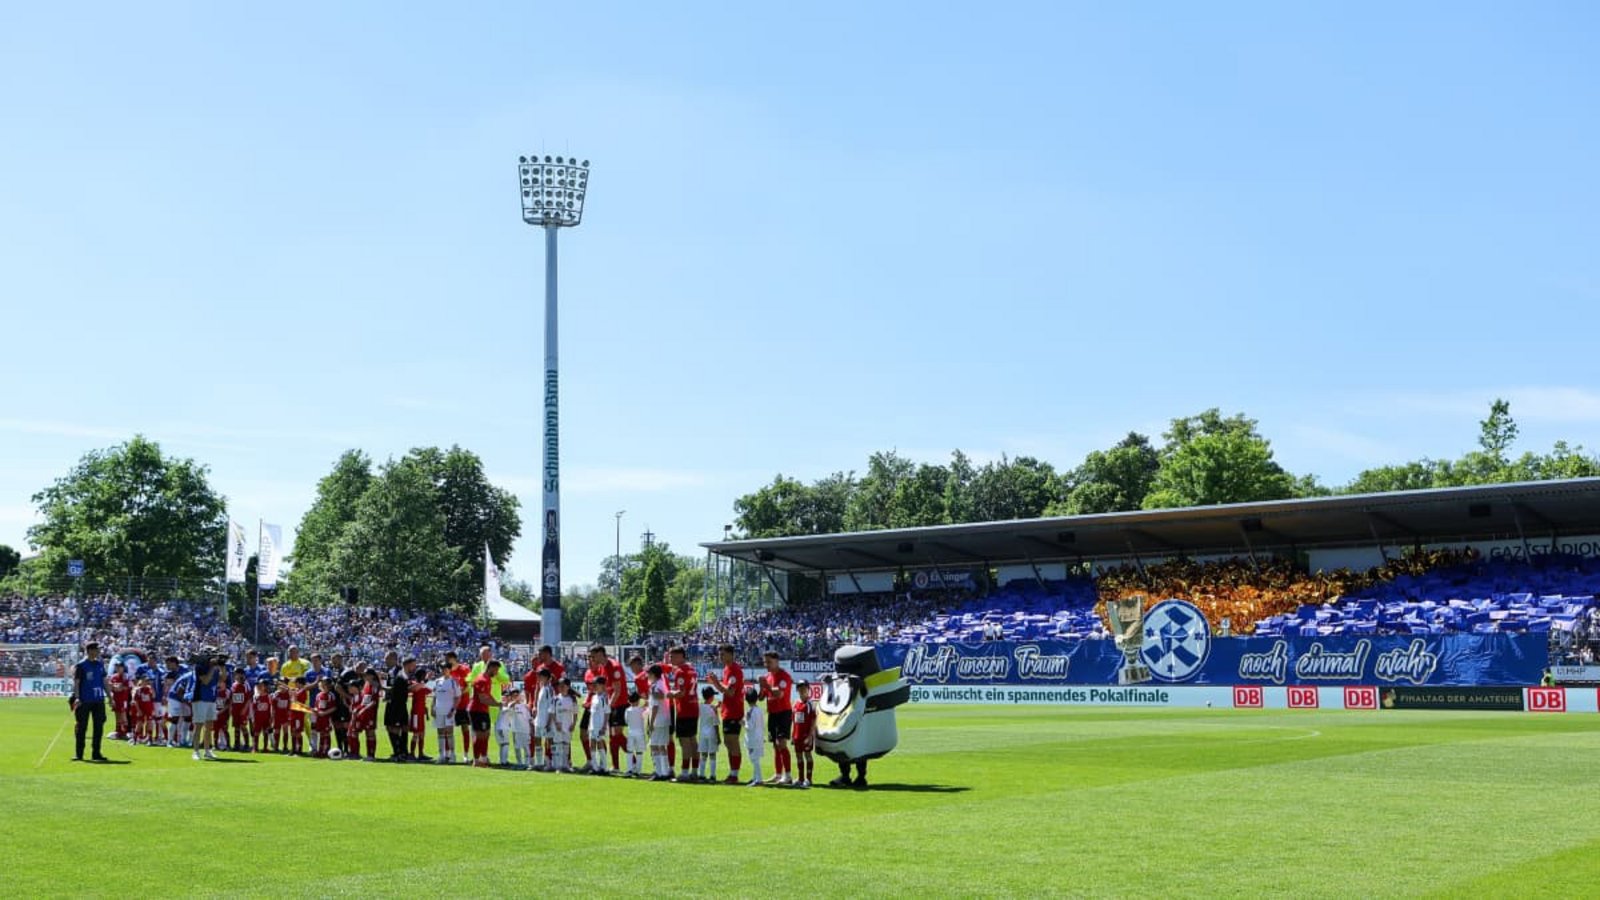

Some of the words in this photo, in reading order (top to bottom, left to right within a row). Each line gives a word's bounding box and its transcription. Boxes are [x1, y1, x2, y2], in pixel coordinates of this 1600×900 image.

[544, 411, 559, 493] Schwaben
[904, 646, 956, 680] Macht
[958, 658, 1007, 677] unsern
[1015, 646, 1067, 677] Traum
[1241, 642, 1286, 682] noch
[1298, 641, 1369, 678] einmal
[1376, 640, 1434, 683] wahr
[932, 687, 982, 700] wünscht
[985, 688, 1005, 700] ein
[1007, 688, 1086, 703] spannendes
[1090, 688, 1169, 702] Pokalfinale
[1236, 689, 1260, 705] DB
[1291, 690, 1315, 705] DB
[1348, 690, 1373, 706] DB
[1400, 695, 1444, 703] FINALTAG
[1447, 695, 1465, 703] DER
[1467, 695, 1522, 704] AMATEURS
[1532, 691, 1561, 708] DB
